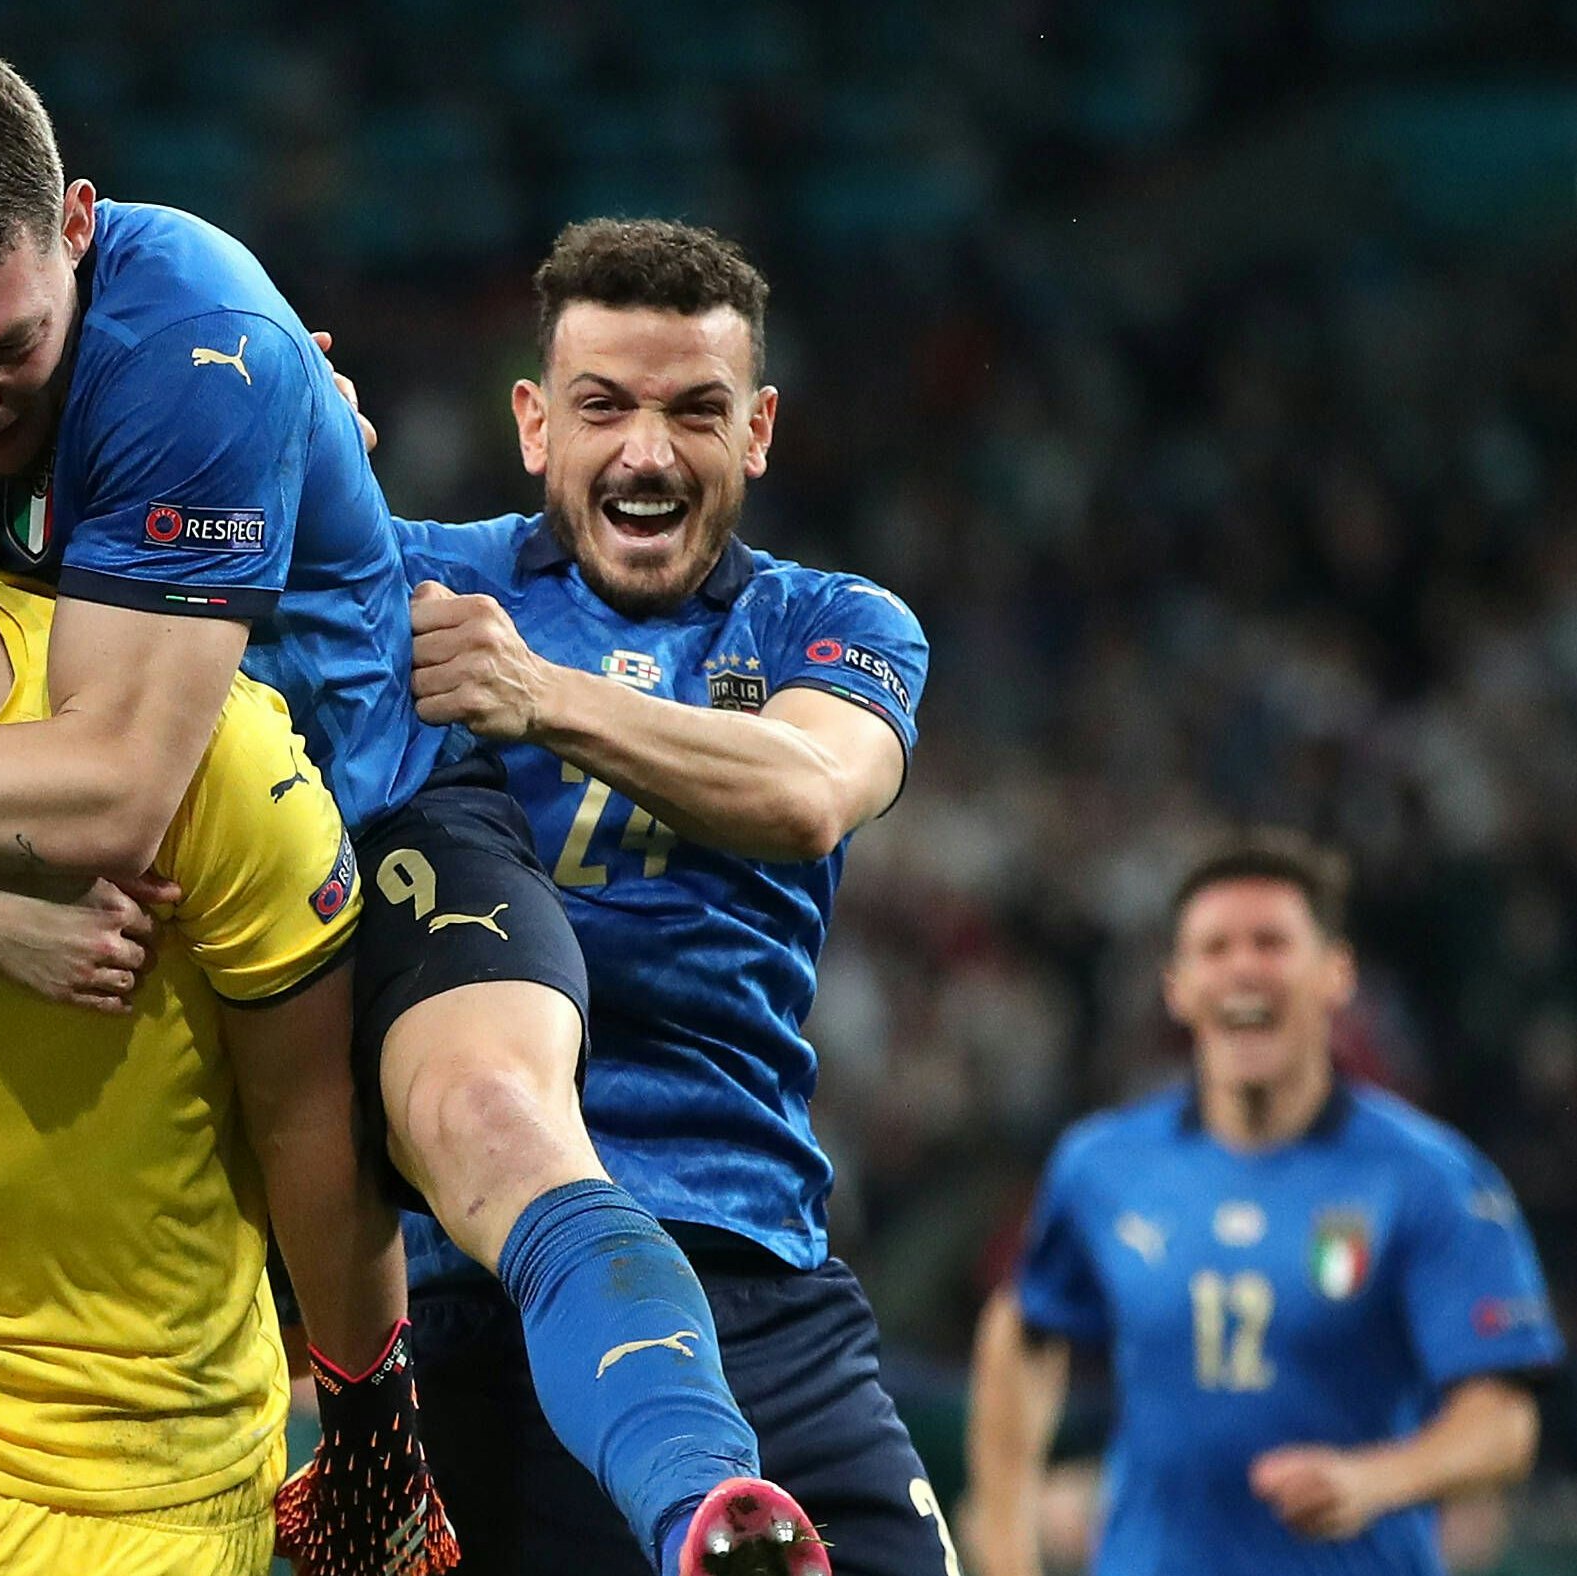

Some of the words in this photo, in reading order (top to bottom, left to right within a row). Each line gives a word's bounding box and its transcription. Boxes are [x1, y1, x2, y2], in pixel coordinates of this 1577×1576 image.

[185, 518, 265, 544] RESPECT
[711, 681, 759, 700] ITALIA
[376, 848, 437, 921] 9
[1190, 1269, 1275, 1390] 12
